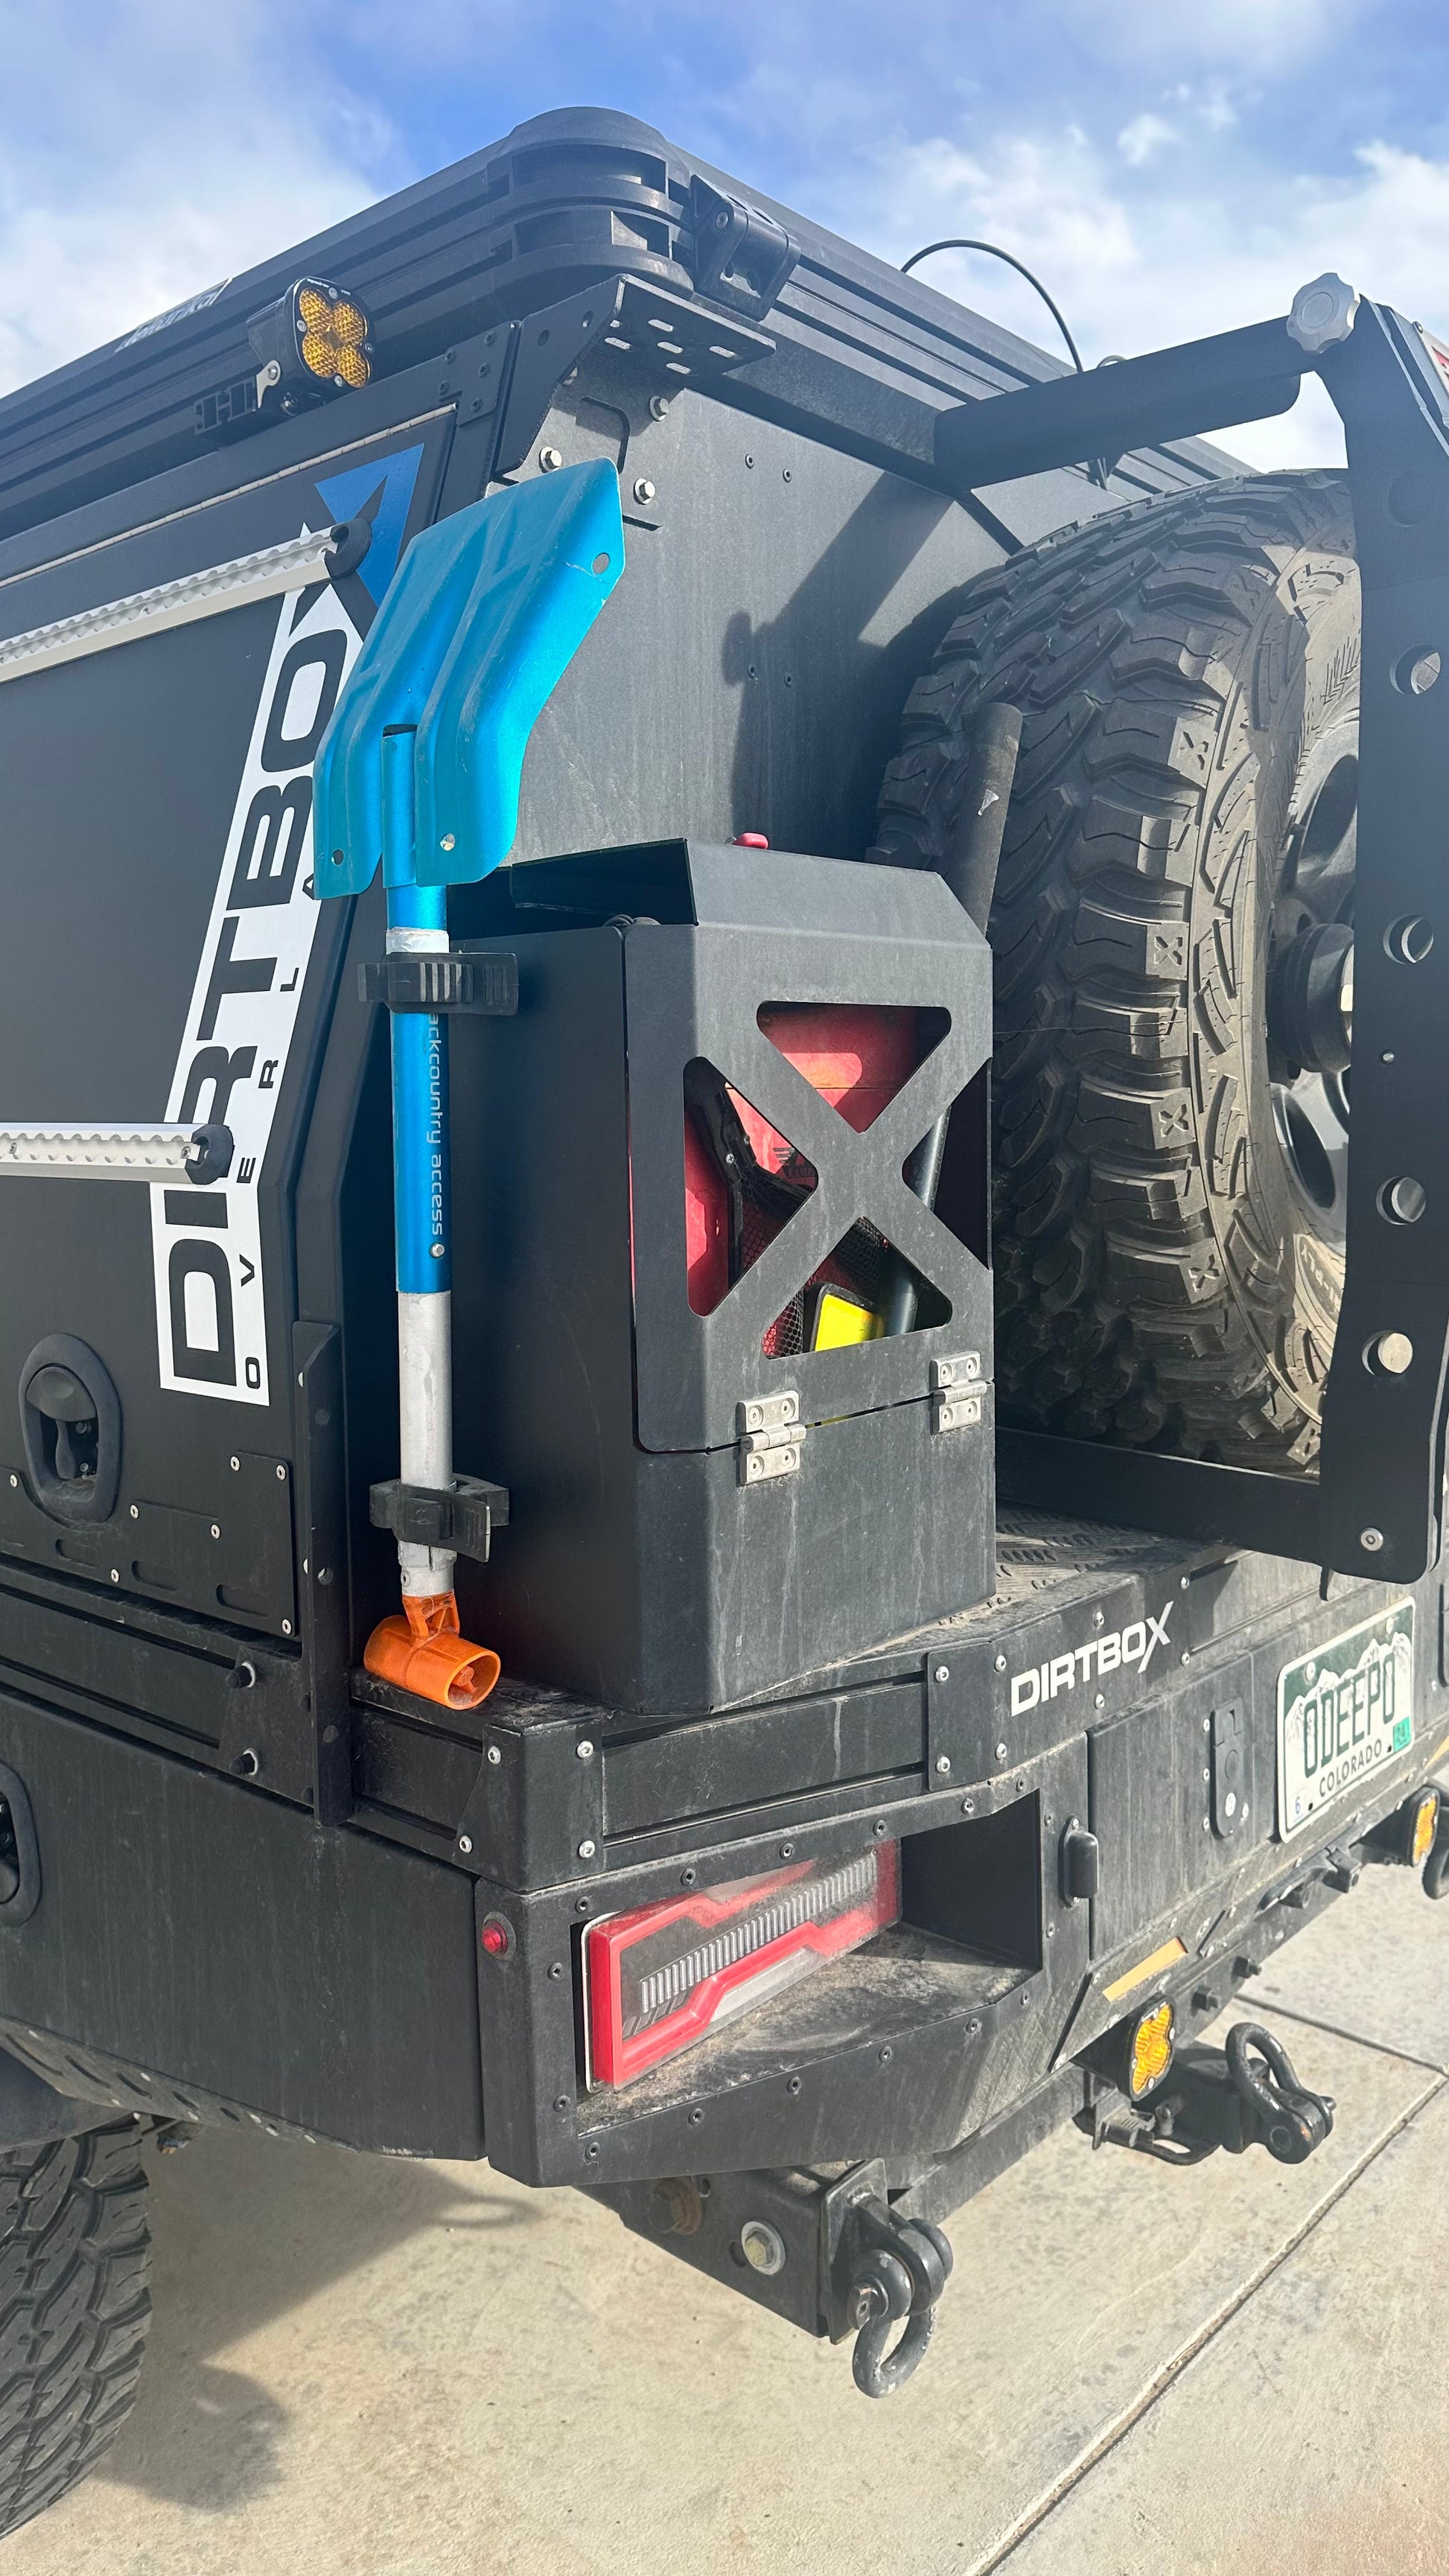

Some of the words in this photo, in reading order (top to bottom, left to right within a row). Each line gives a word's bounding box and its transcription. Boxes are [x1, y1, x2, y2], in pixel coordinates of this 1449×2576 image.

[164, 474, 387, 1387] DIRTBOX
[237, 873, 314, 1389] OVERLA
[426, 1013, 443, 1144] ackcountry
[431, 1153, 443, 1236] access
[1010, 1601, 1173, 1717] DIRTBOX
[1319, 1738, 1382, 1797] COLORADO
